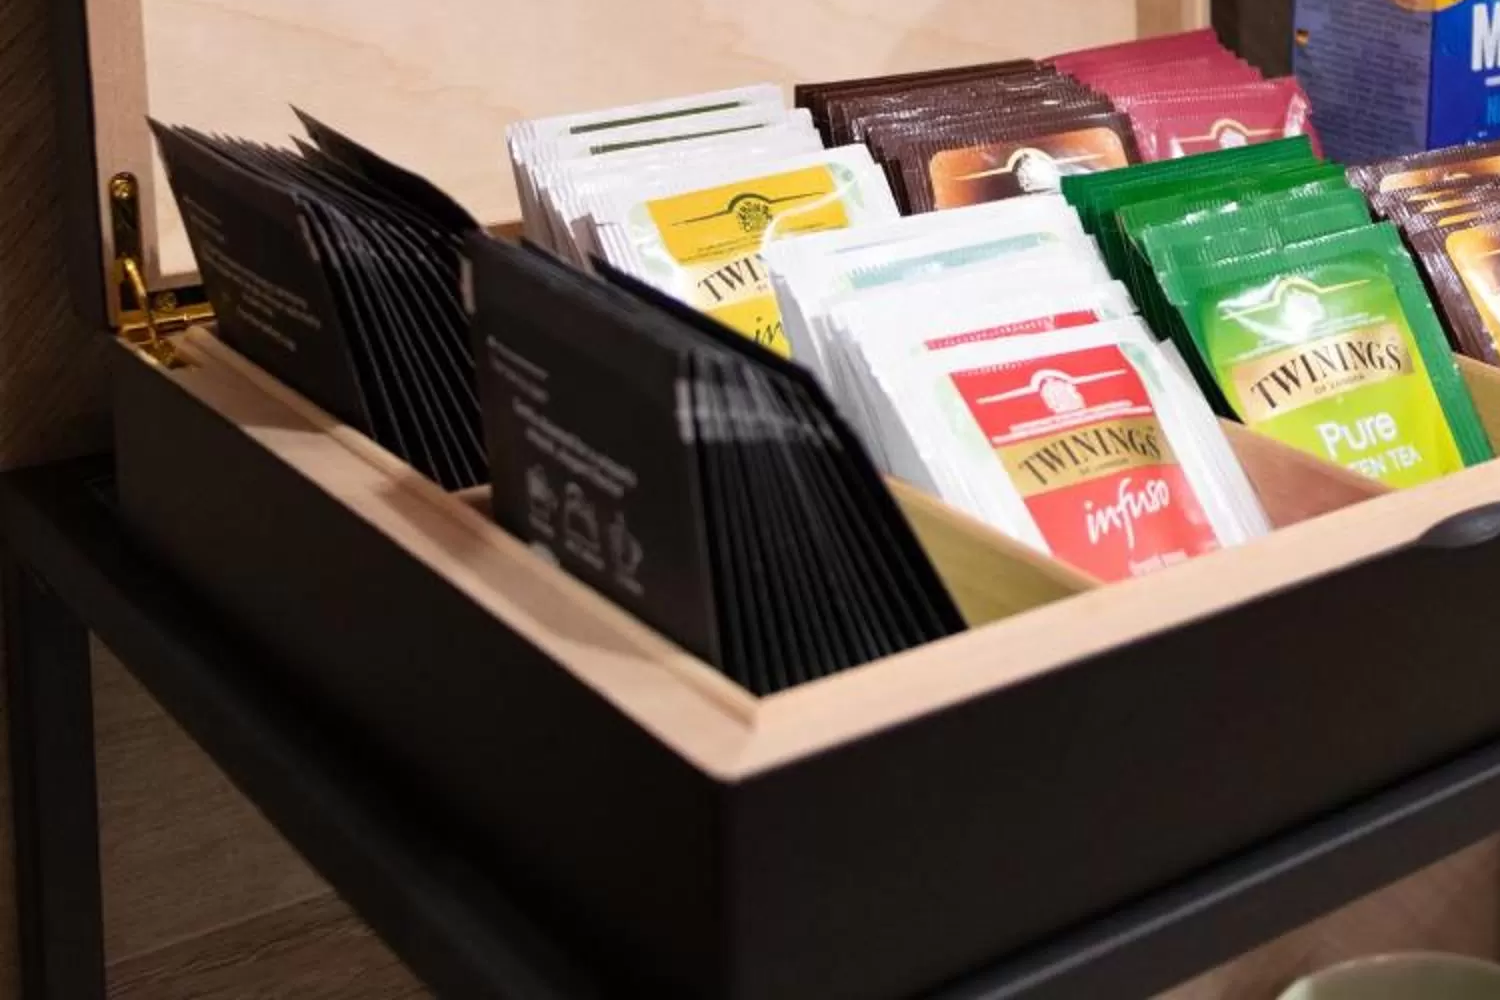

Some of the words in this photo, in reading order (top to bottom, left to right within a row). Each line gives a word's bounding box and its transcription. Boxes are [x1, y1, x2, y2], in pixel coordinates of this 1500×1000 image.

[1250, 340, 1402, 409] TWININGS
[1018, 425, 1162, 485] TWININGS
[1316, 411, 1398, 461] Pure
[1387, 445, 1422, 472] TEA
[1084, 477, 1170, 549] infuso
